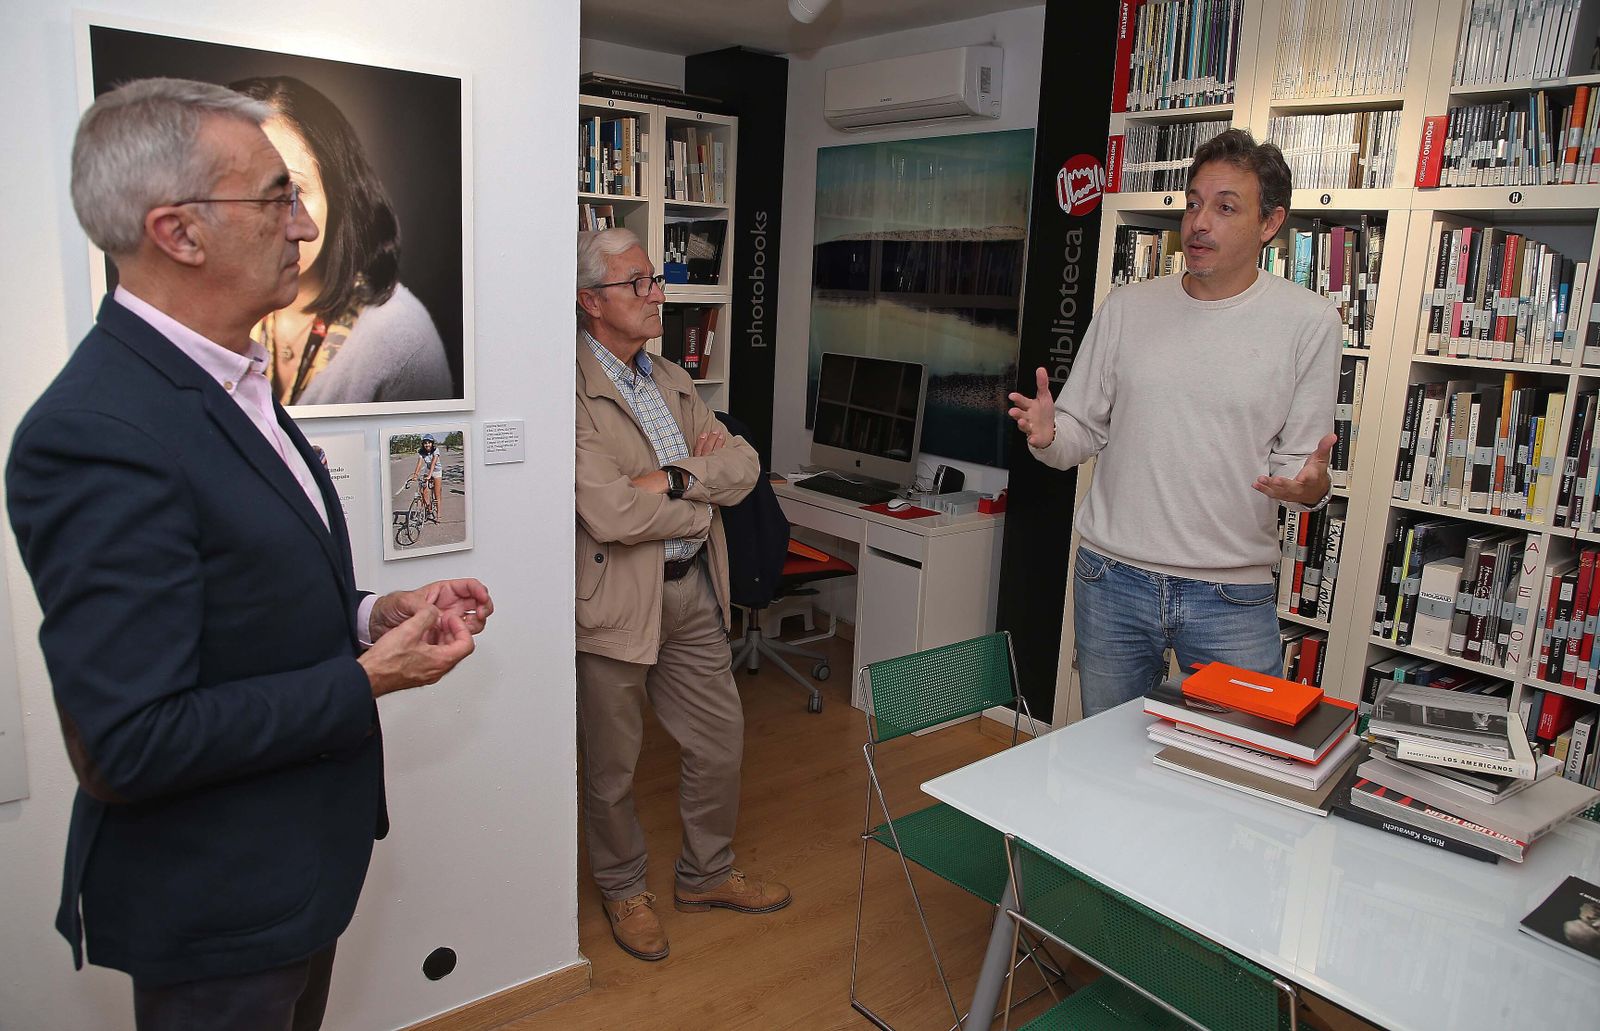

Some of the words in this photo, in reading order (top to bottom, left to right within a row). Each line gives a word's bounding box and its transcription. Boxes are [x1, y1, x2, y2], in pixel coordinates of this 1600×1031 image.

[1120, 2, 1129, 40] APERTURE
[1421, 120, 1434, 156] PEQUEÑO
[1107, 140, 1117, 188] PHOTOBOLSILLO
[1419, 156, 1428, 183] formato
[746, 210, 768, 348] photobooks
[1048, 227, 1083, 383] biblioteca
[1420, 591, 1452, 603] THOUSAND
[1443, 756, 1458, 764] LOS
[1460, 758, 1513, 773] AMERICANOS
[1424, 808, 1461, 825] KLEIN
[1381, 822, 1421, 841] Kawauchi
[1422, 834, 1445, 848] Rinko
